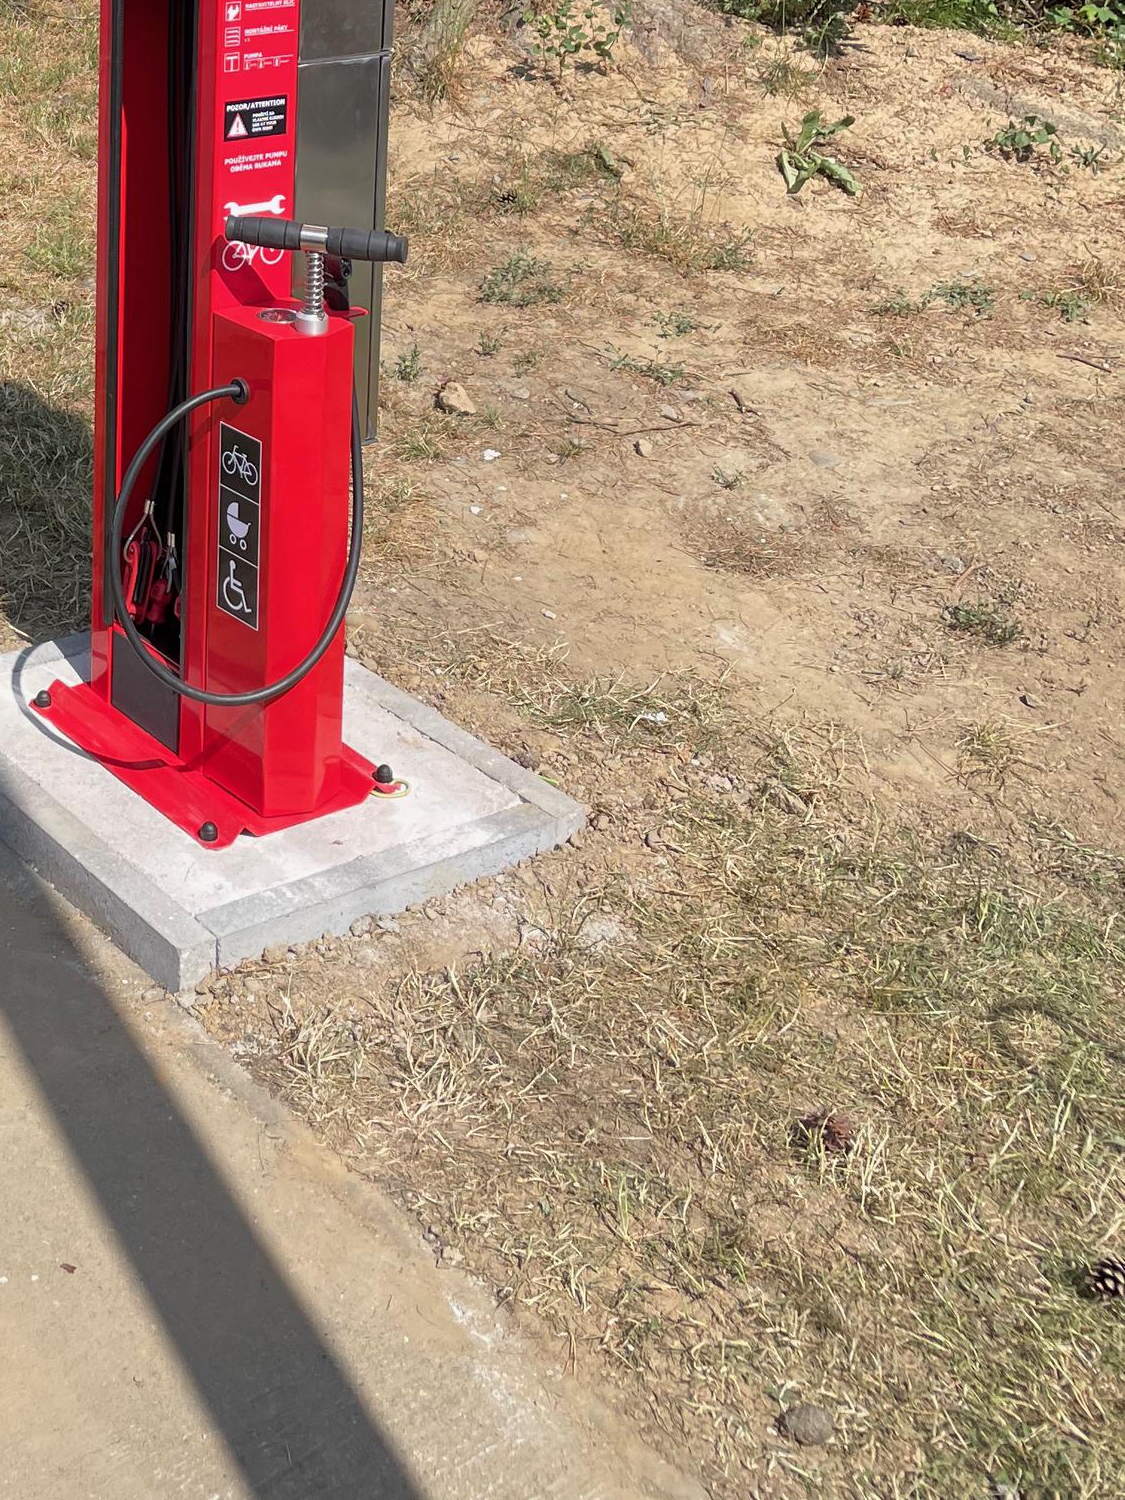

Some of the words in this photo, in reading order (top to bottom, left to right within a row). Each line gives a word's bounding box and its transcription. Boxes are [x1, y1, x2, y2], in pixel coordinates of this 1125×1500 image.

[245, 0, 282, 9] NASTAVITELNÝ
[226, 98, 286, 112] POZOR/ATTENTION
[224, 154, 264, 165] POUŽÍVEJTE
[265, 150, 288, 159] PUMPU
[230, 162, 253, 173] OBĚMA
[254, 160, 282, 170] RUKAMA
